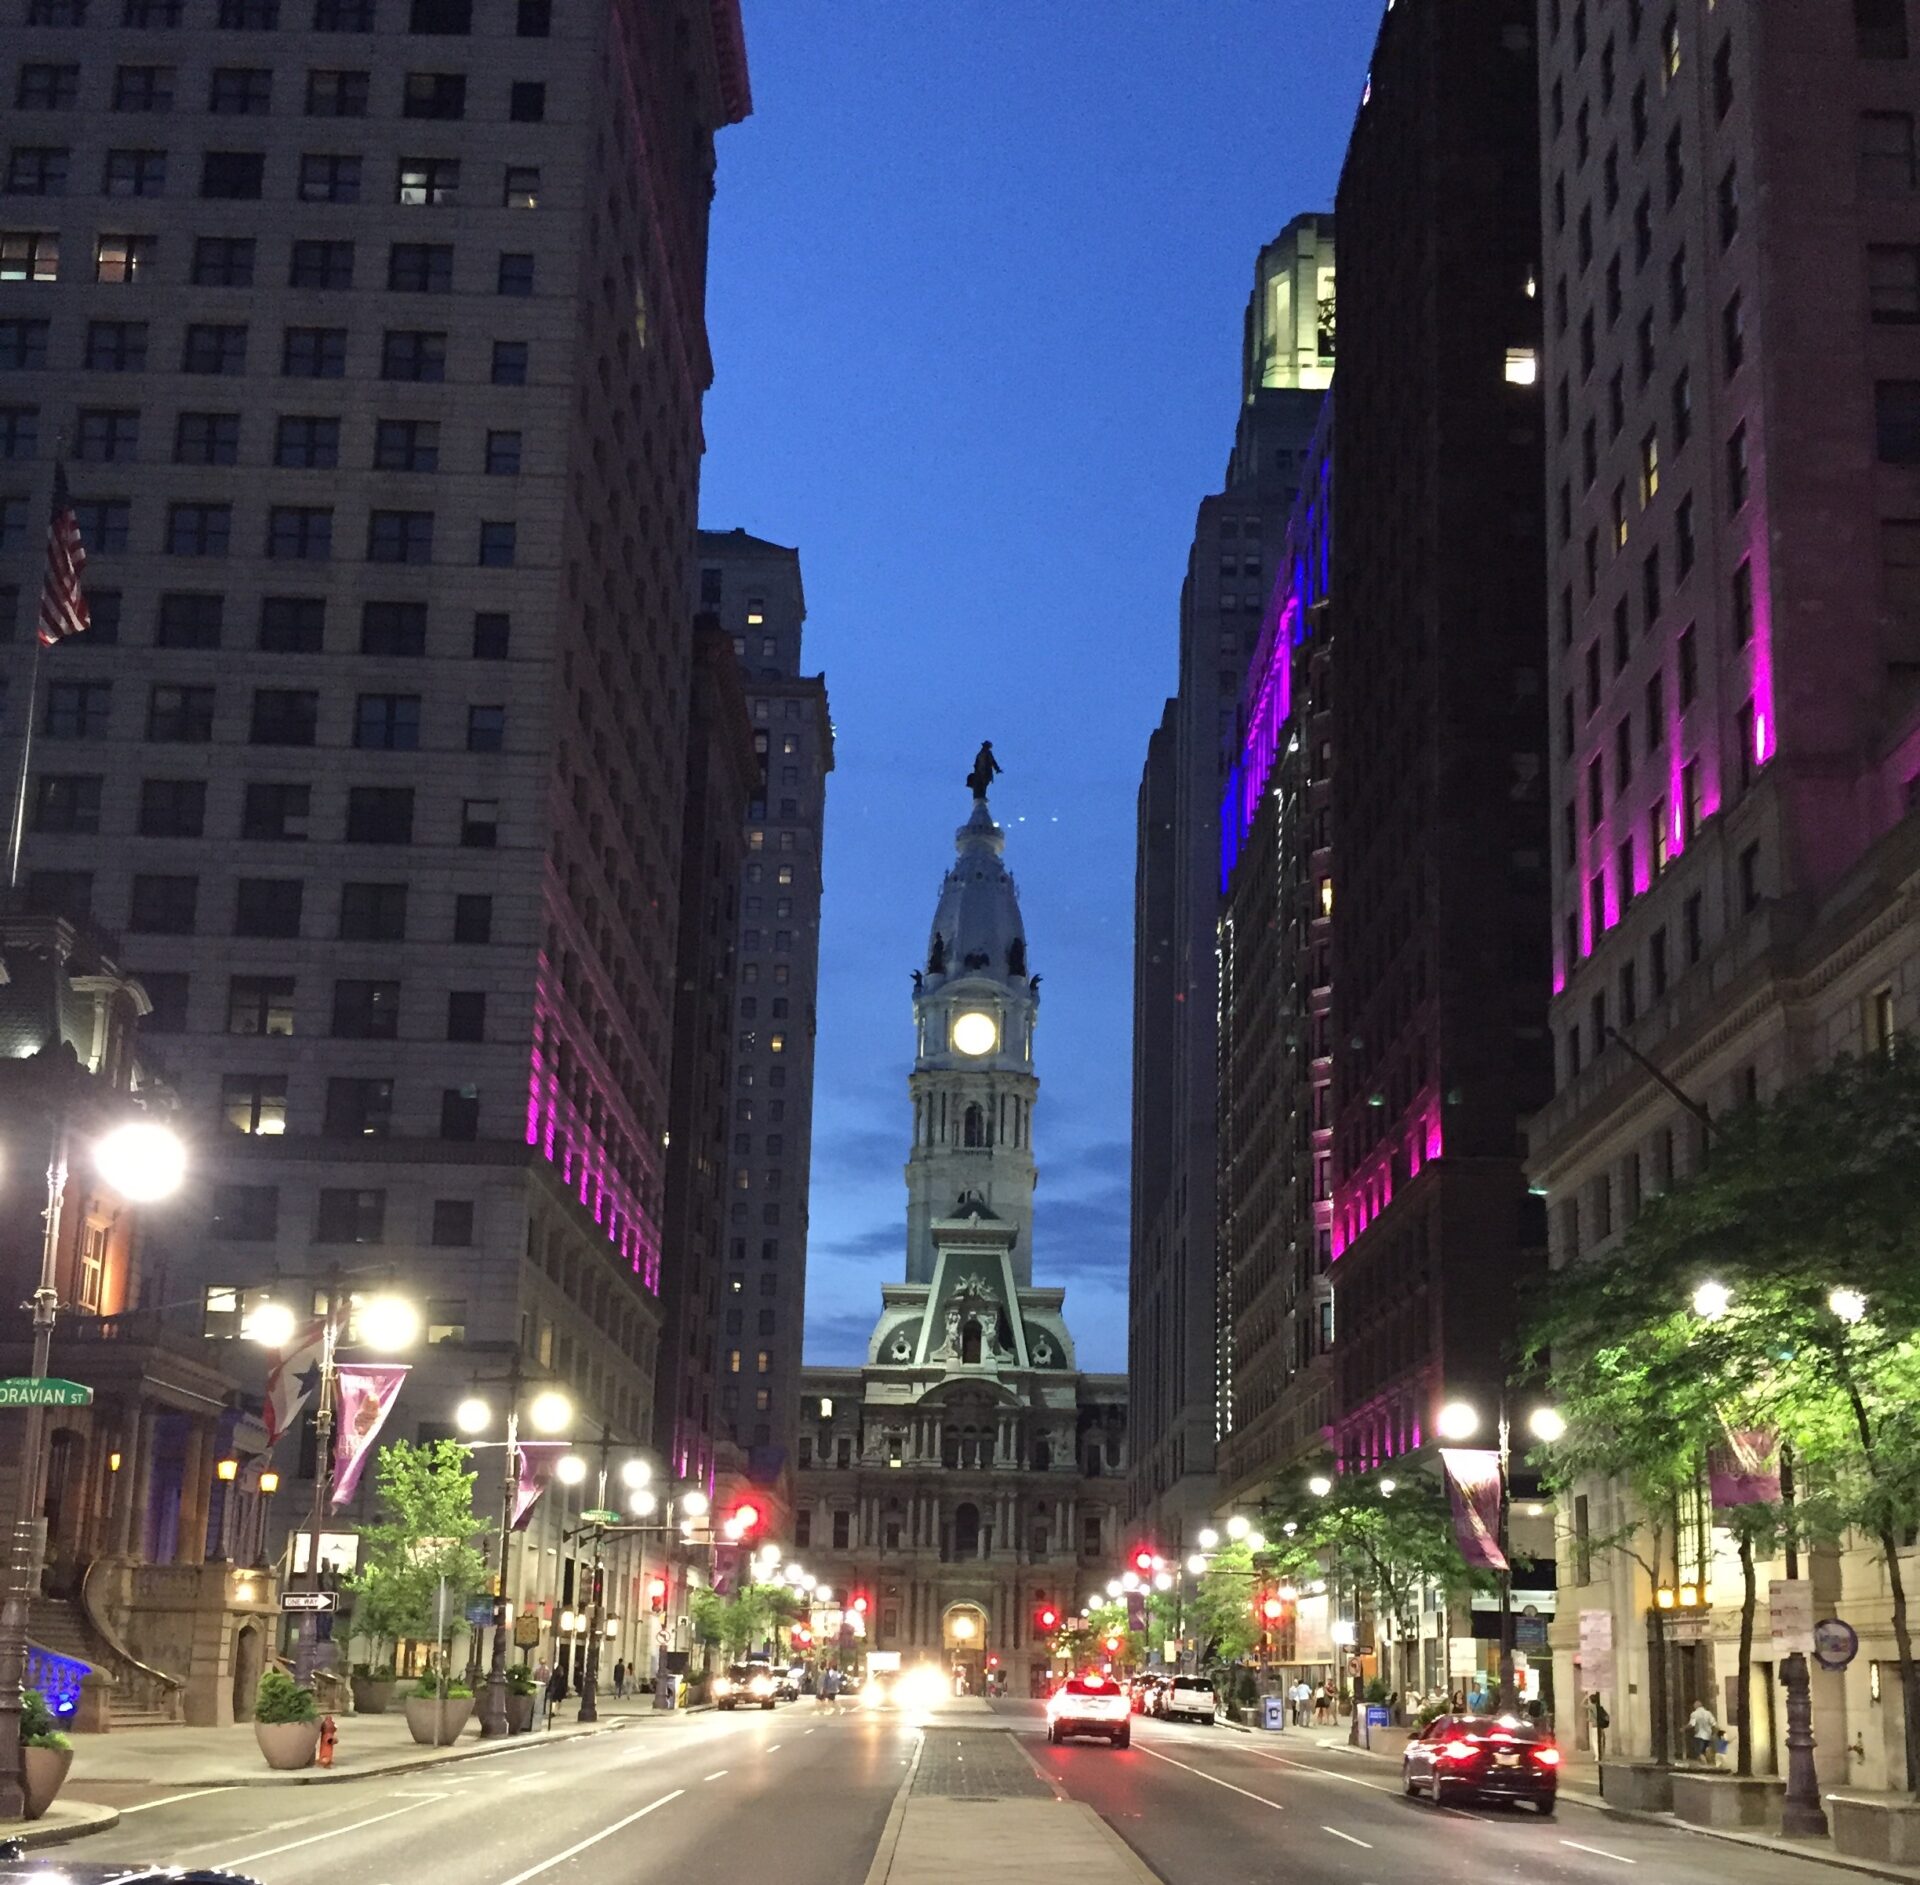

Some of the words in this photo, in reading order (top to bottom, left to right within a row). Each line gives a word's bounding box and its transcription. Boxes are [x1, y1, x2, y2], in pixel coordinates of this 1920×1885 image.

[0, 1388, 66, 1403] ORAVIAN
[70, 1393, 83, 1404] ST
[287, 1598, 300, 1606] ONE
[303, 1598, 318, 1606] WAY
